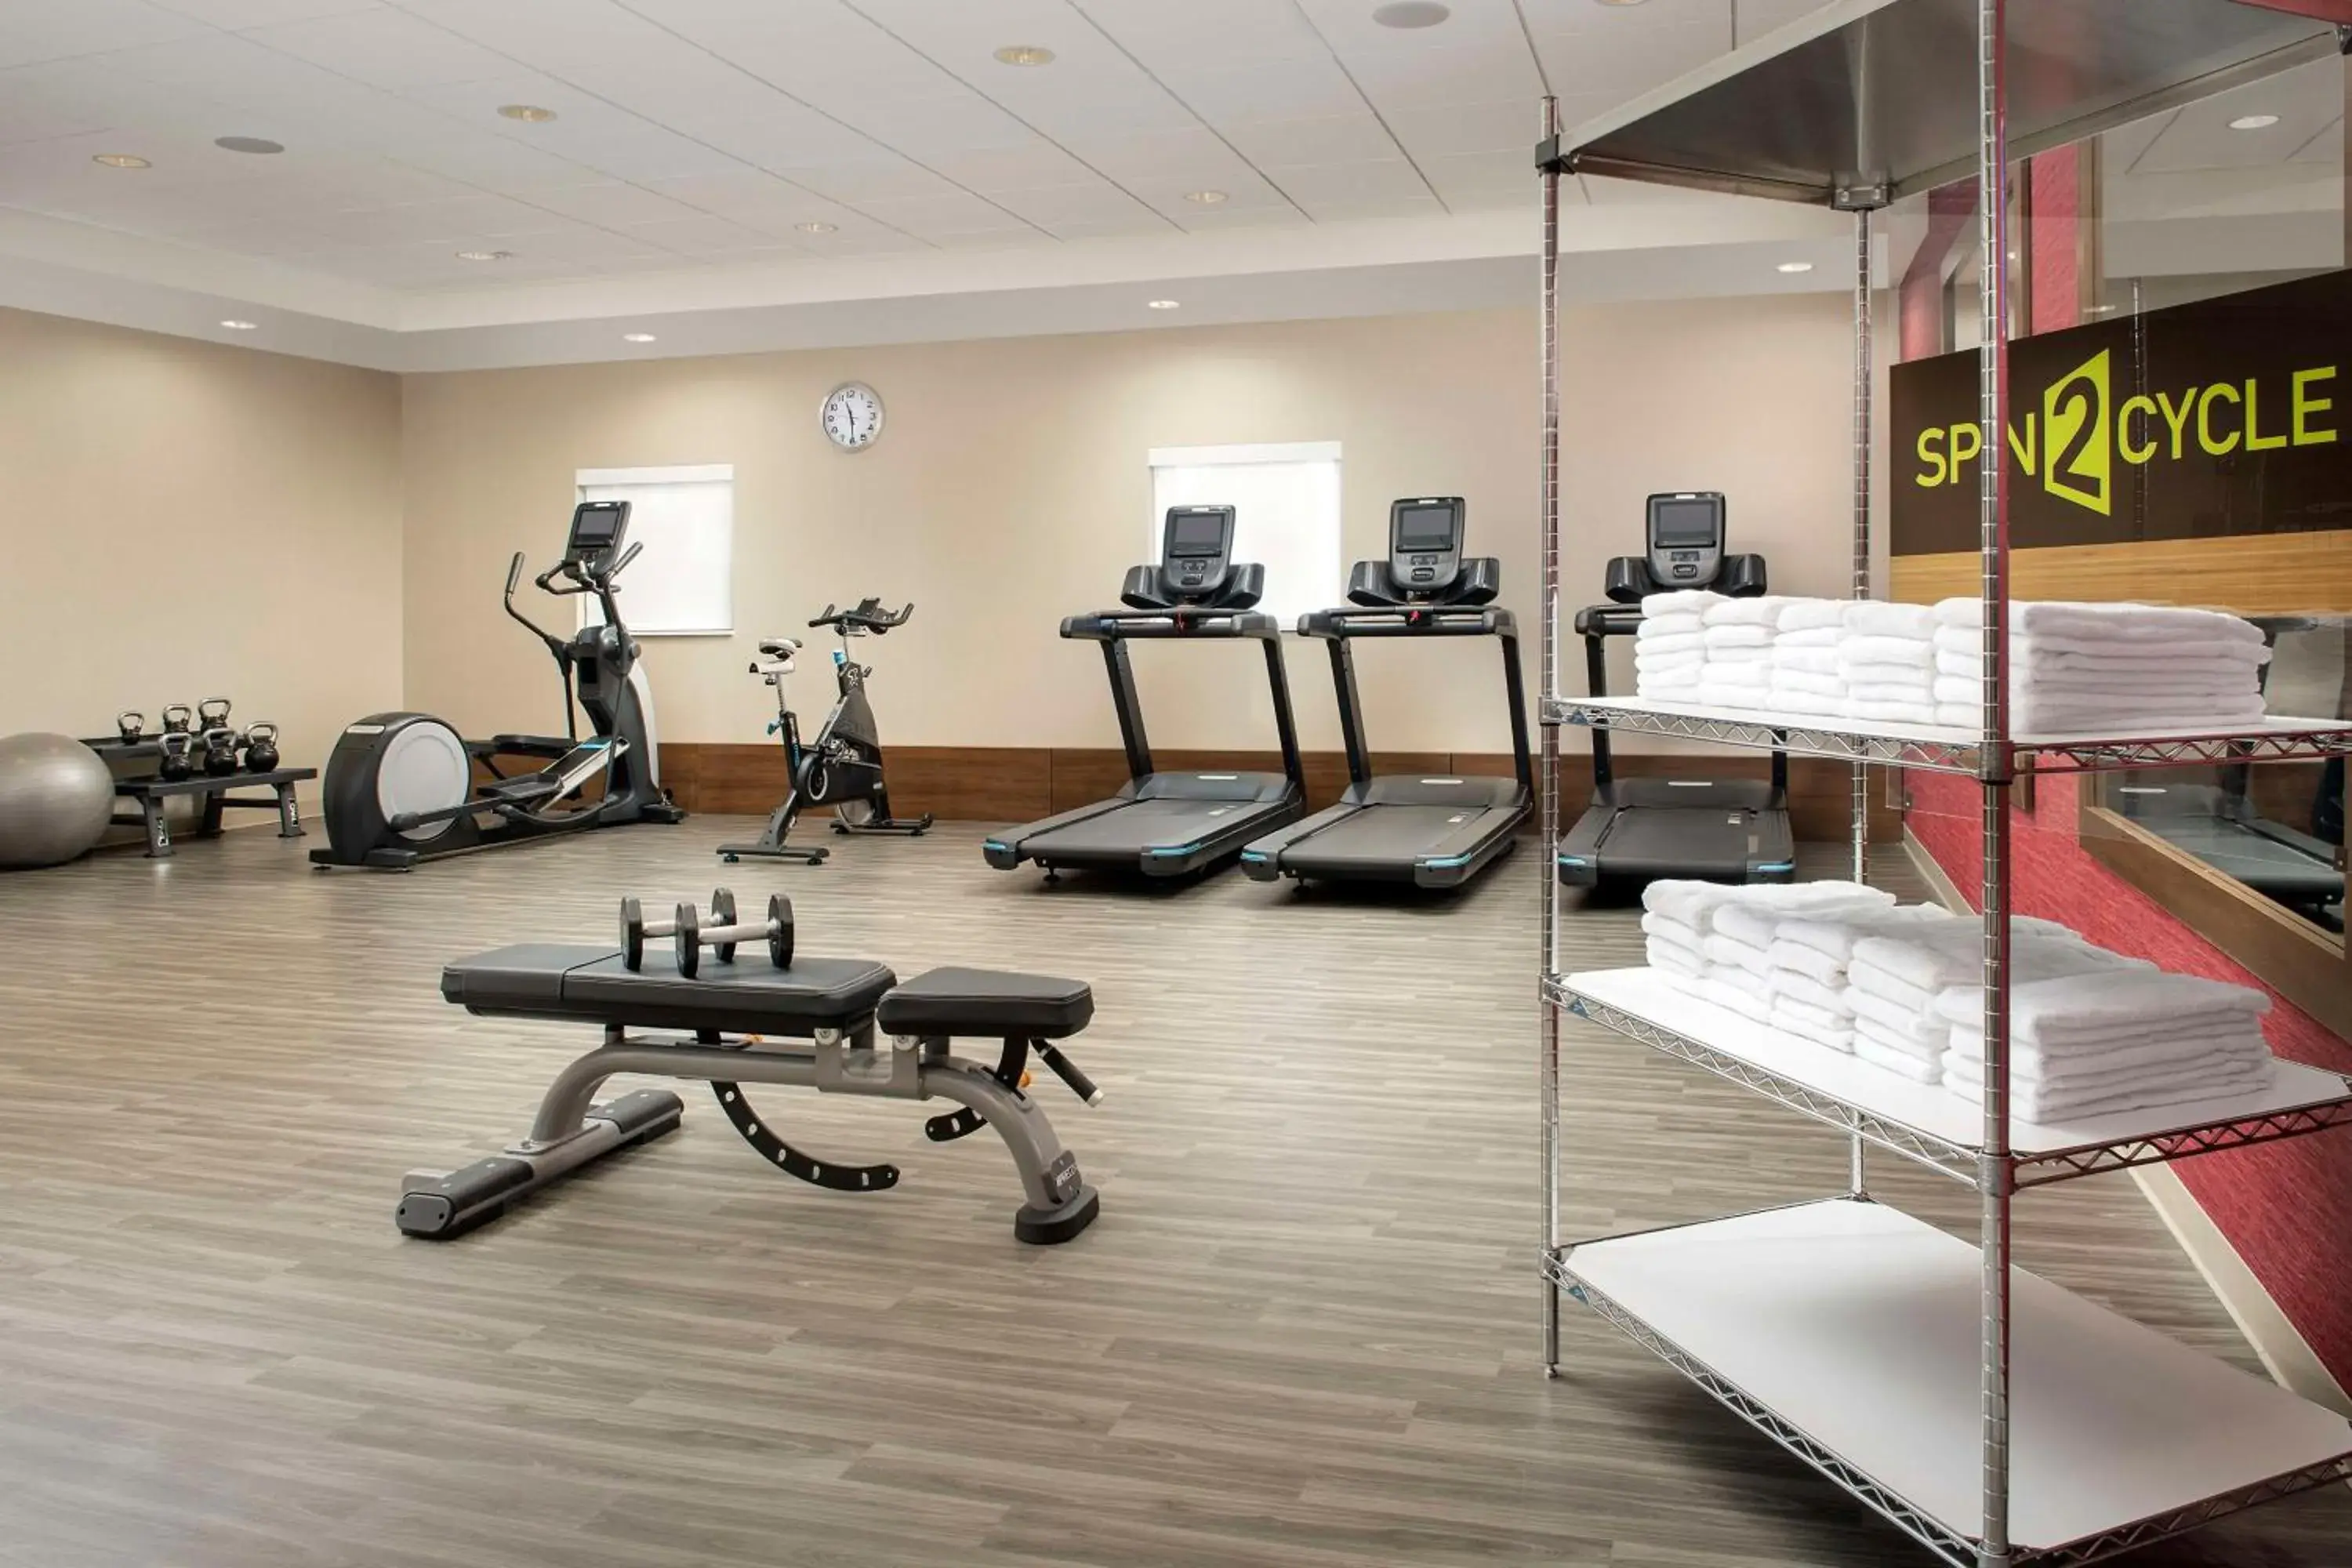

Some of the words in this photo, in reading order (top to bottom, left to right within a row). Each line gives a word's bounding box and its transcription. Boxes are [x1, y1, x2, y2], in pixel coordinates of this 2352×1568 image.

[846, 390, 855, 398] 12
[1915, 412, 2036, 488] SPN
[2051, 374, 2102, 499] 2
[2118, 365, 2338, 465] CYCLE
